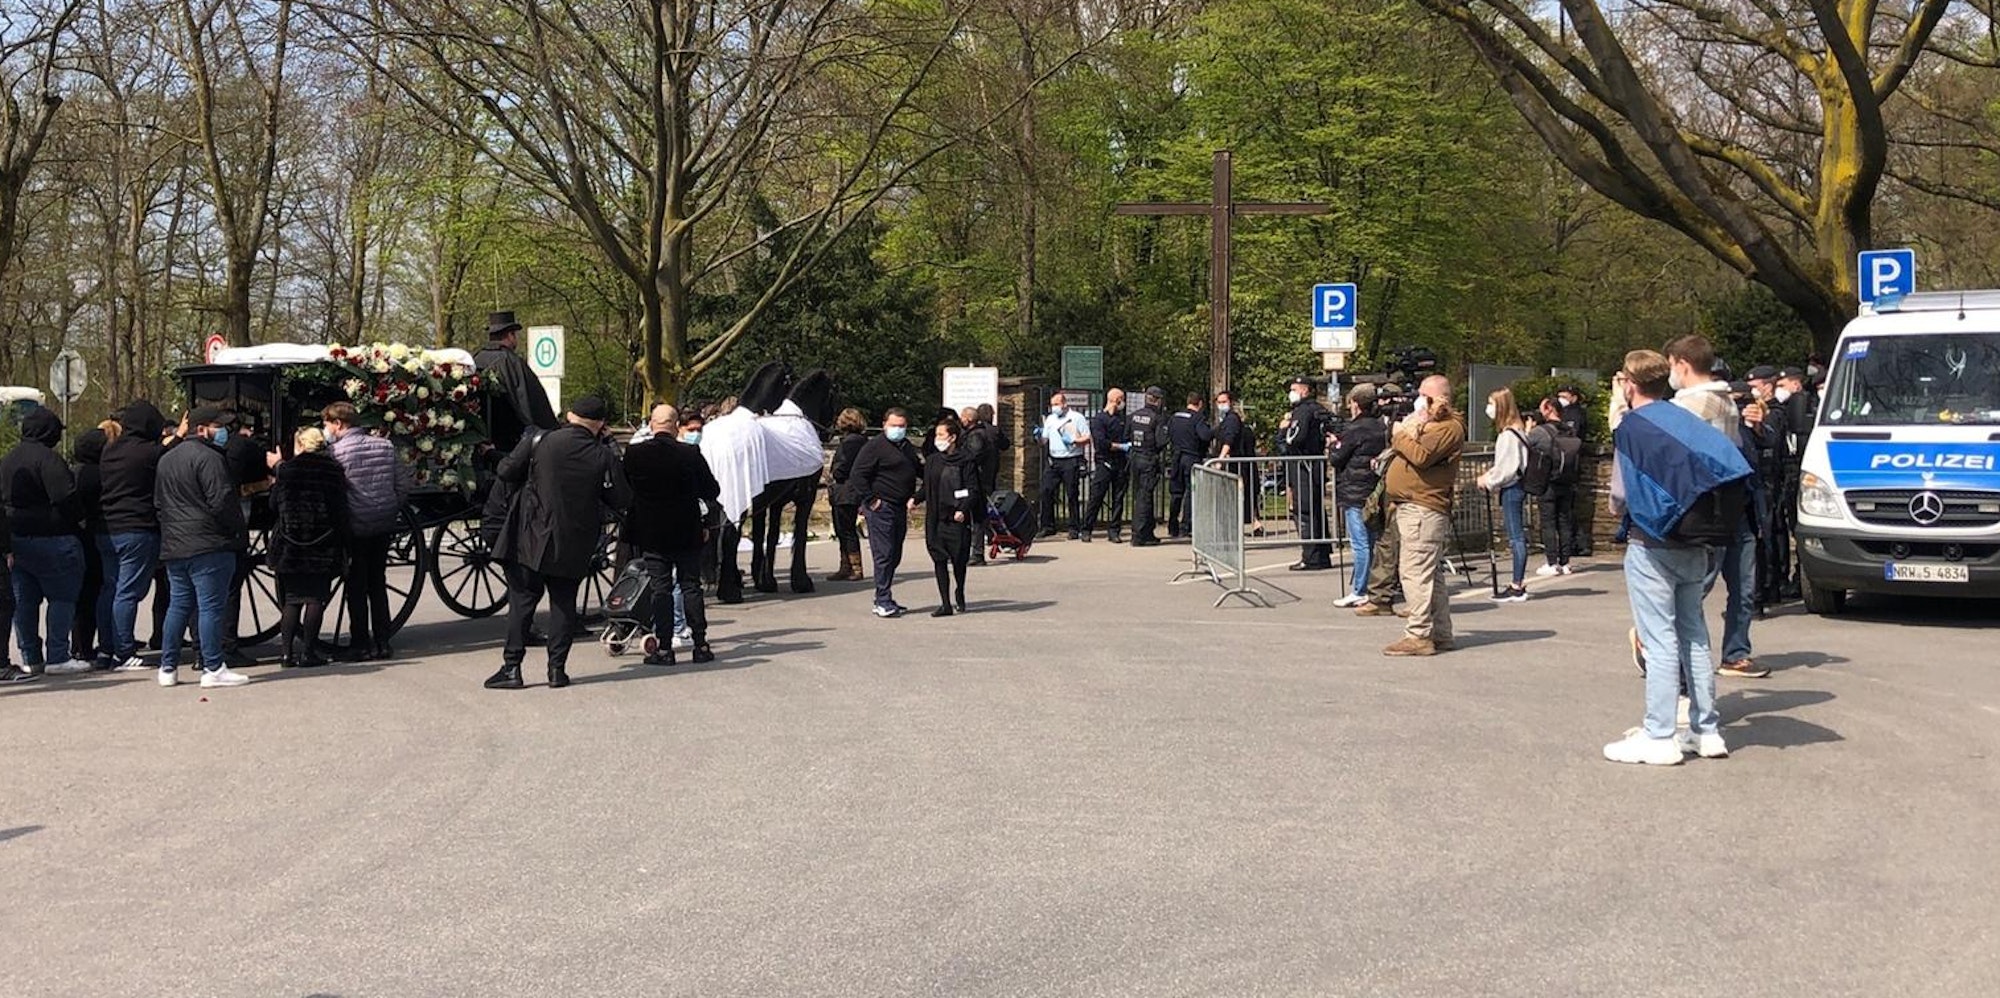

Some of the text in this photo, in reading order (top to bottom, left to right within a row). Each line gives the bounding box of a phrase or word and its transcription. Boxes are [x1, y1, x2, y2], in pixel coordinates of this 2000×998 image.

[1872, 257, 1901, 296] P
[1323, 290, 1346, 323] P
[541, 343, 551, 361] H
[1870, 453, 1995, 470] POLIZEI
[1893, 566, 1915, 578] NRW
[1937, 567, 1967, 580] 4834
